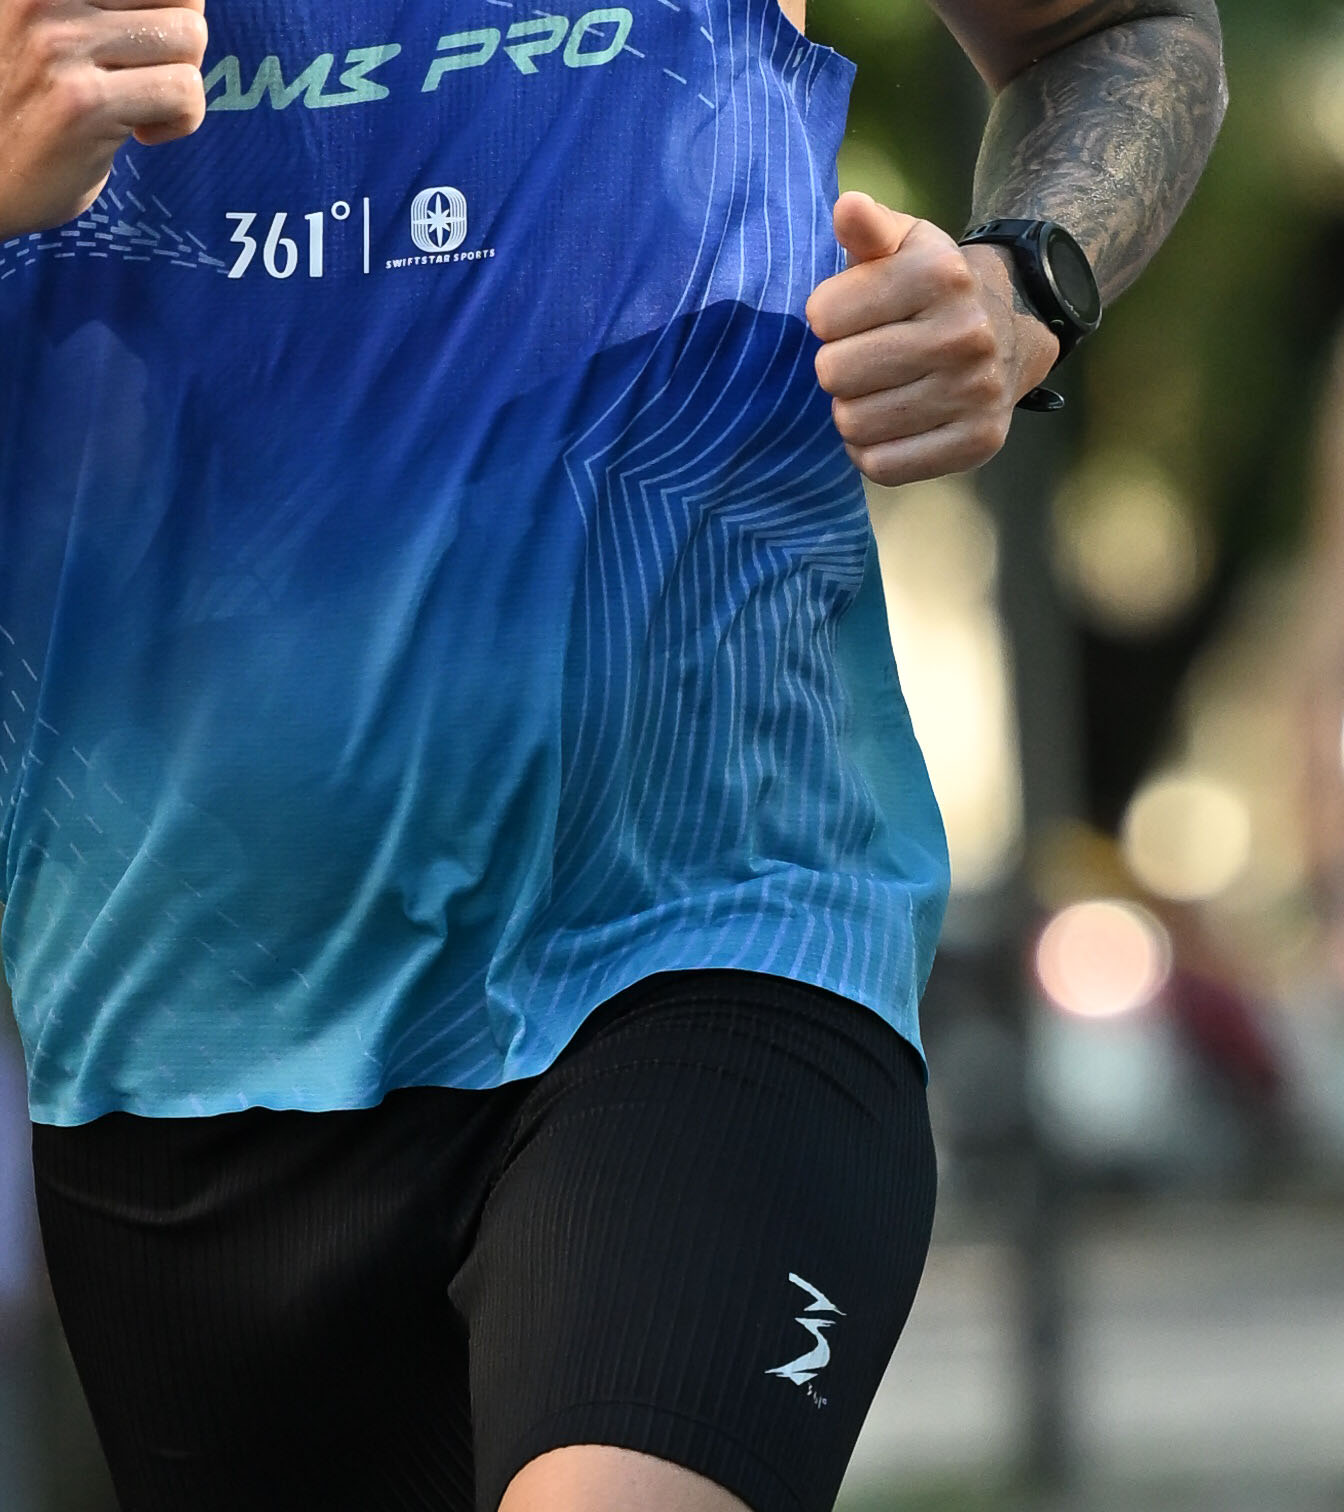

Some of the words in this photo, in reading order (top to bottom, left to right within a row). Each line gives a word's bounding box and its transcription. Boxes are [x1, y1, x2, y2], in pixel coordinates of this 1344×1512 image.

[421, 7, 634, 93] PRO
[225, 200, 351, 279] 361°
[384, 254, 451, 270] SWIFTSTAR
[453, 248, 496, 263] SPORTS
